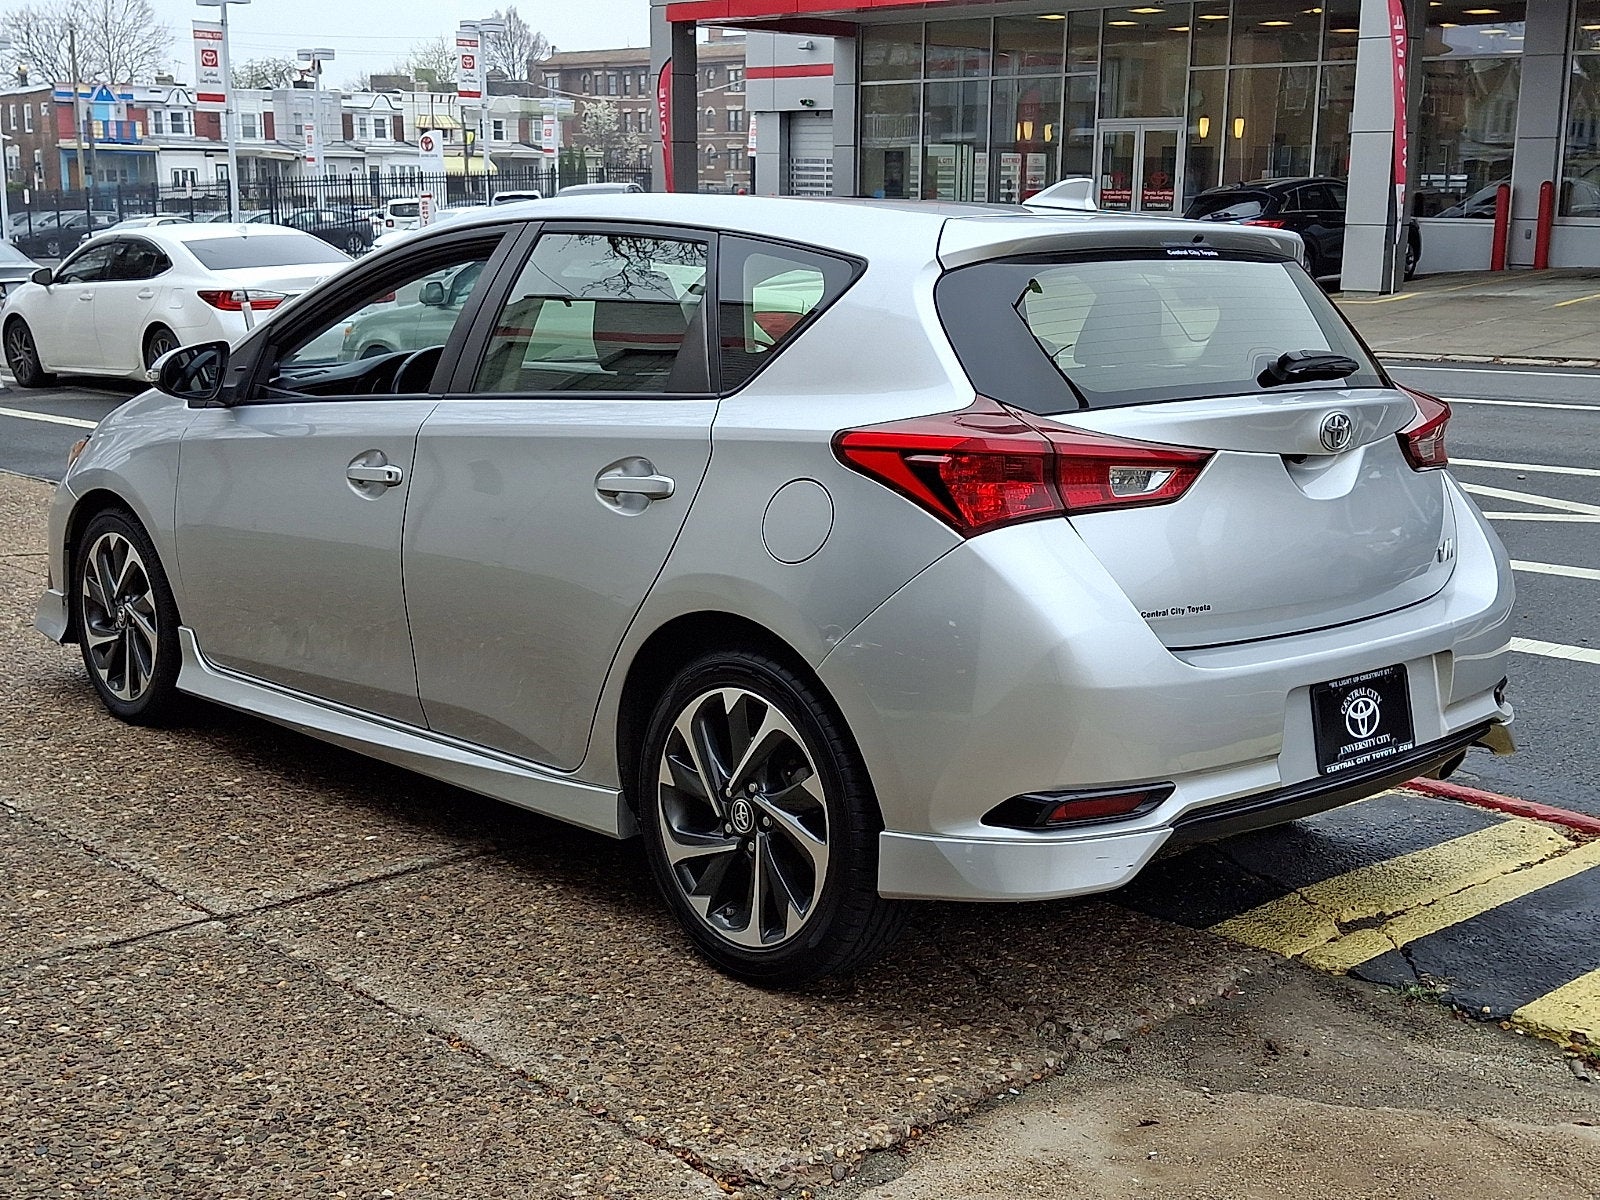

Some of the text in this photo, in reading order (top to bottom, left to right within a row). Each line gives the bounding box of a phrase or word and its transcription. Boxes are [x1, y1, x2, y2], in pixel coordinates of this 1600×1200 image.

[1188, 249, 1200, 257] City
[1200, 249, 1219, 257] Toyota
[1141, 604, 1211, 619] Central City Toyota
[1339, 678, 1352, 687] LIGHT
[1340, 687, 1382, 715] CENTRAL CITY
[1340, 733, 1391, 755] UNIVERSITY CITY
[1326, 743, 1414, 774] CENTRAL CITY TOYOTA .COM
